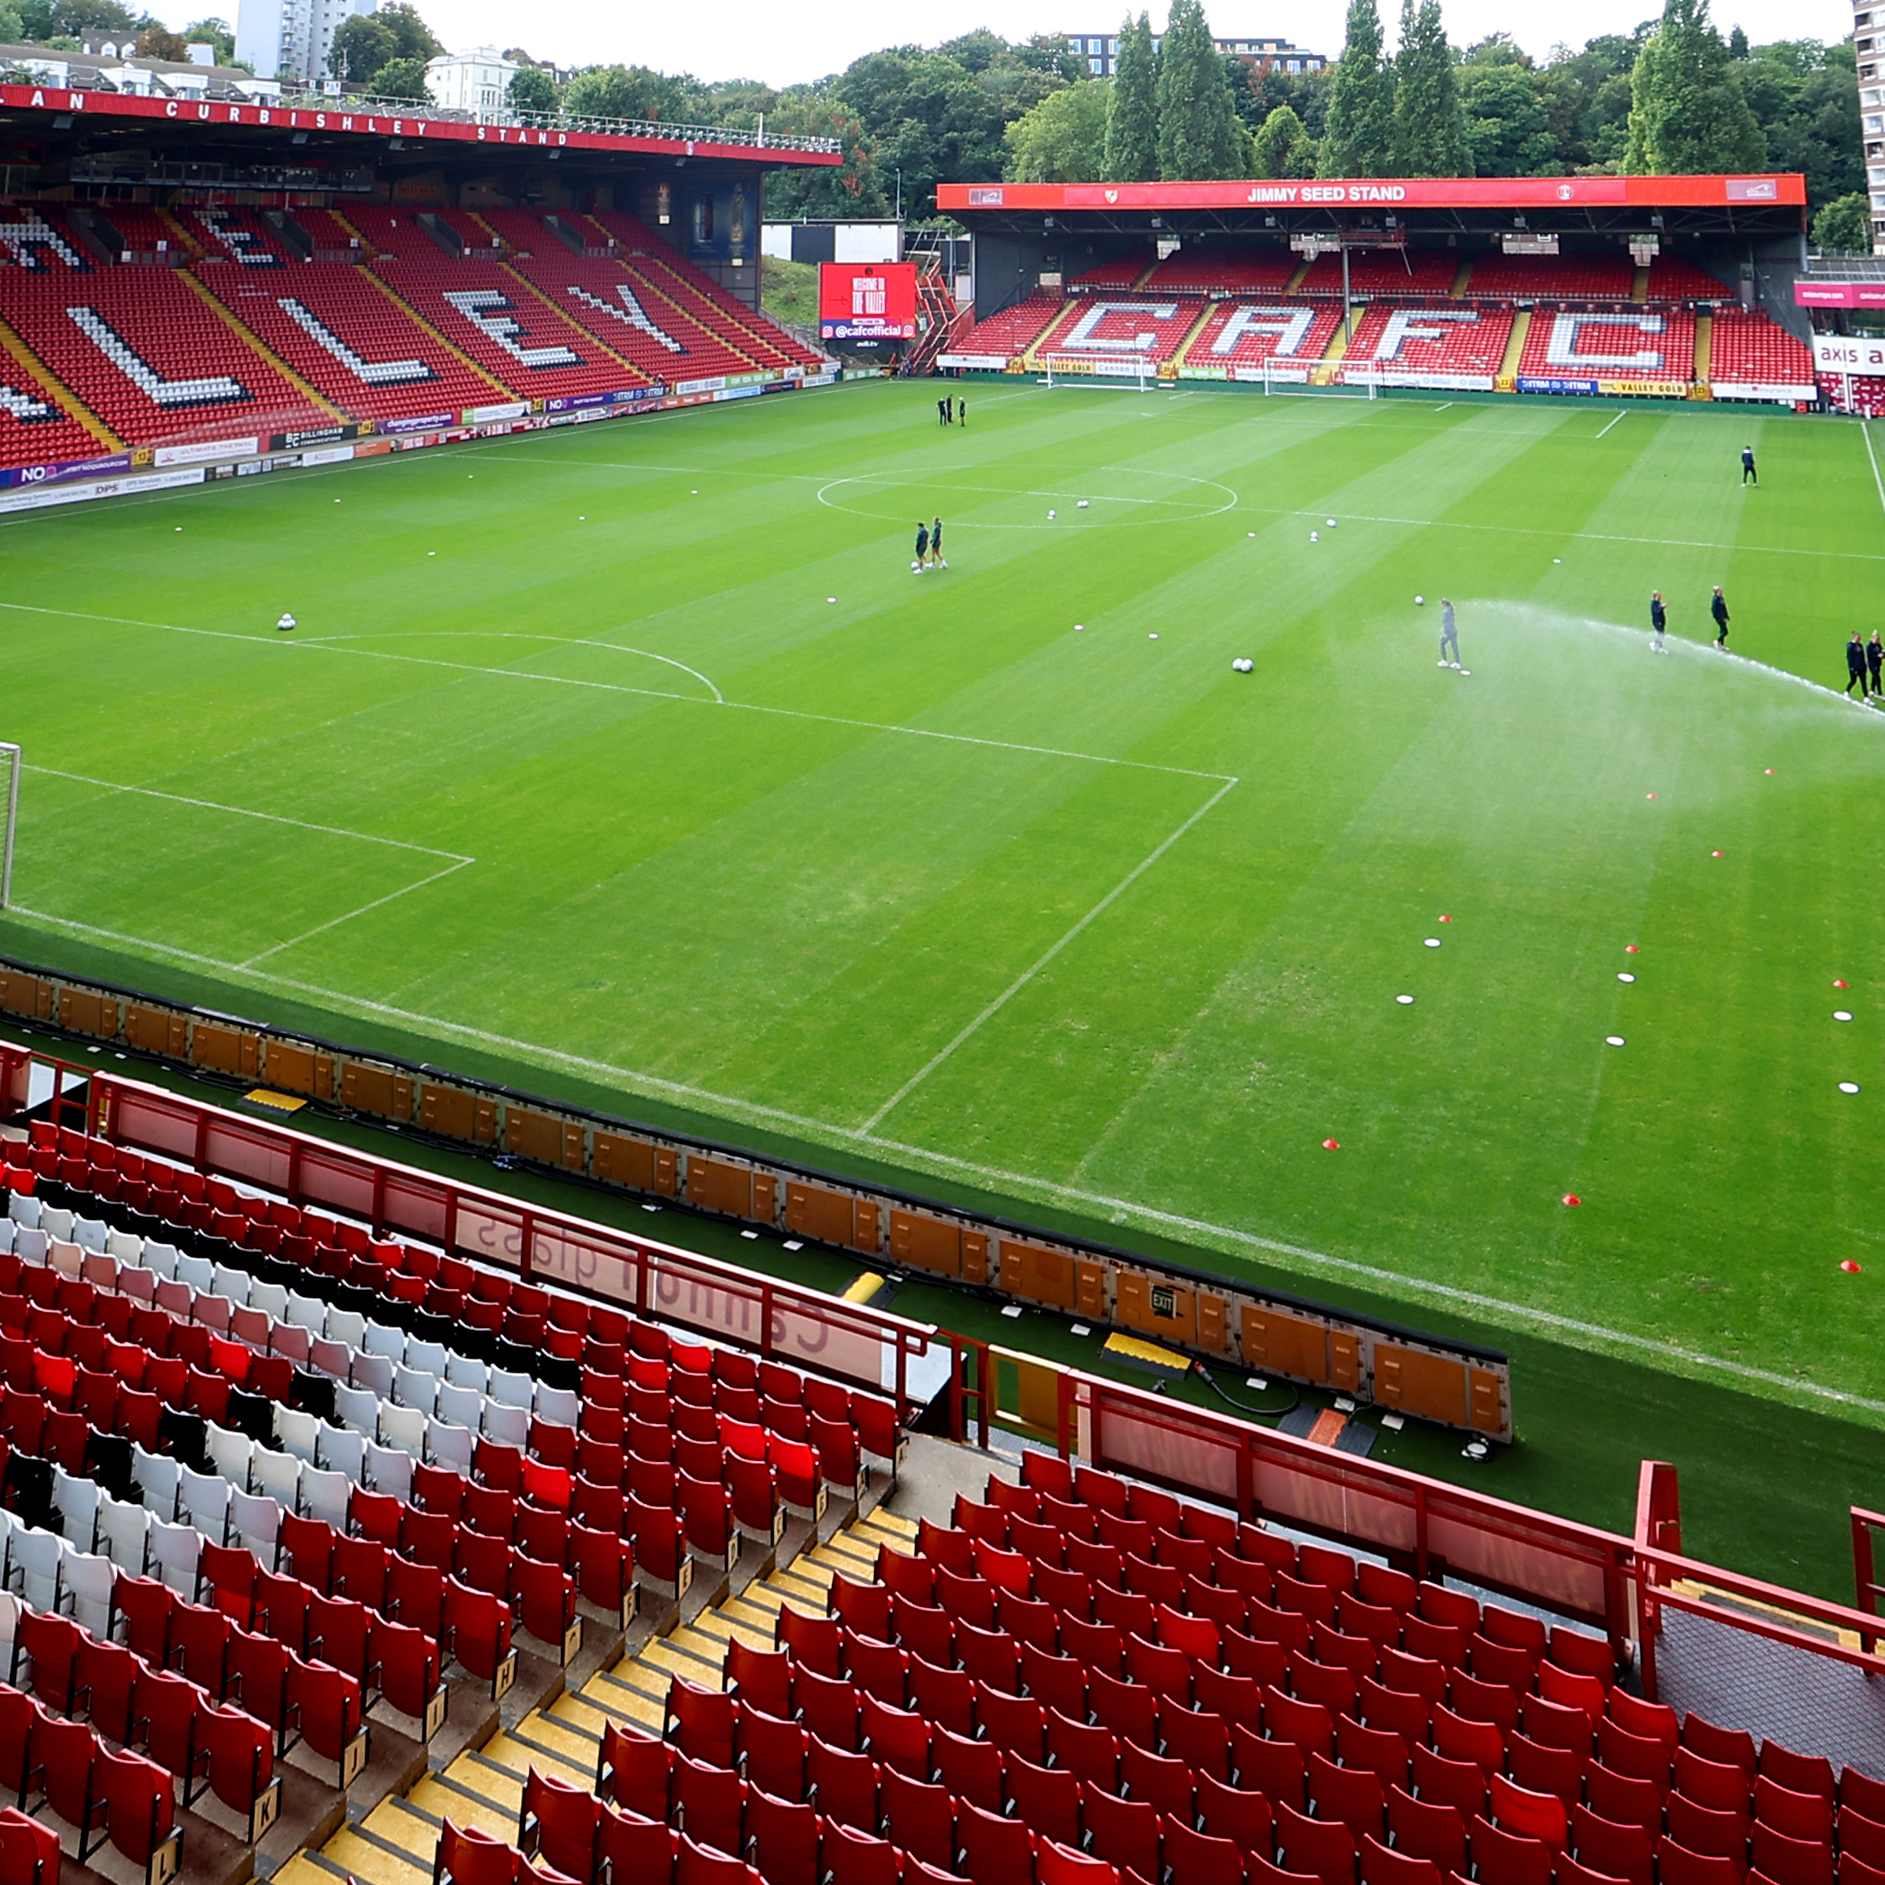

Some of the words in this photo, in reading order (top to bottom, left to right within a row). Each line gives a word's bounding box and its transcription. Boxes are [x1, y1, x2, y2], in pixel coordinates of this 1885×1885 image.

[166, 100, 427, 136] CURBISHLEY
[476, 126, 568, 147] STAND
[1247, 188, 1298, 202] JIMMY
[1301, 187, 1345, 201] SEED
[1349, 186, 1405, 200] STAND
[835, 325, 902, 338] @cafcofficial
[1820, 344, 1858, 365] axis
[1098, 364, 1130, 373] Cannon
[1621, 384, 1653, 392] VALLEY
[1659, 385, 1683, 393] GOLD
[301, 427, 344, 439] BILLINGHAM
[95, 484, 119, 495] DPS
[1154, 1292, 1173, 1311] EXIT
